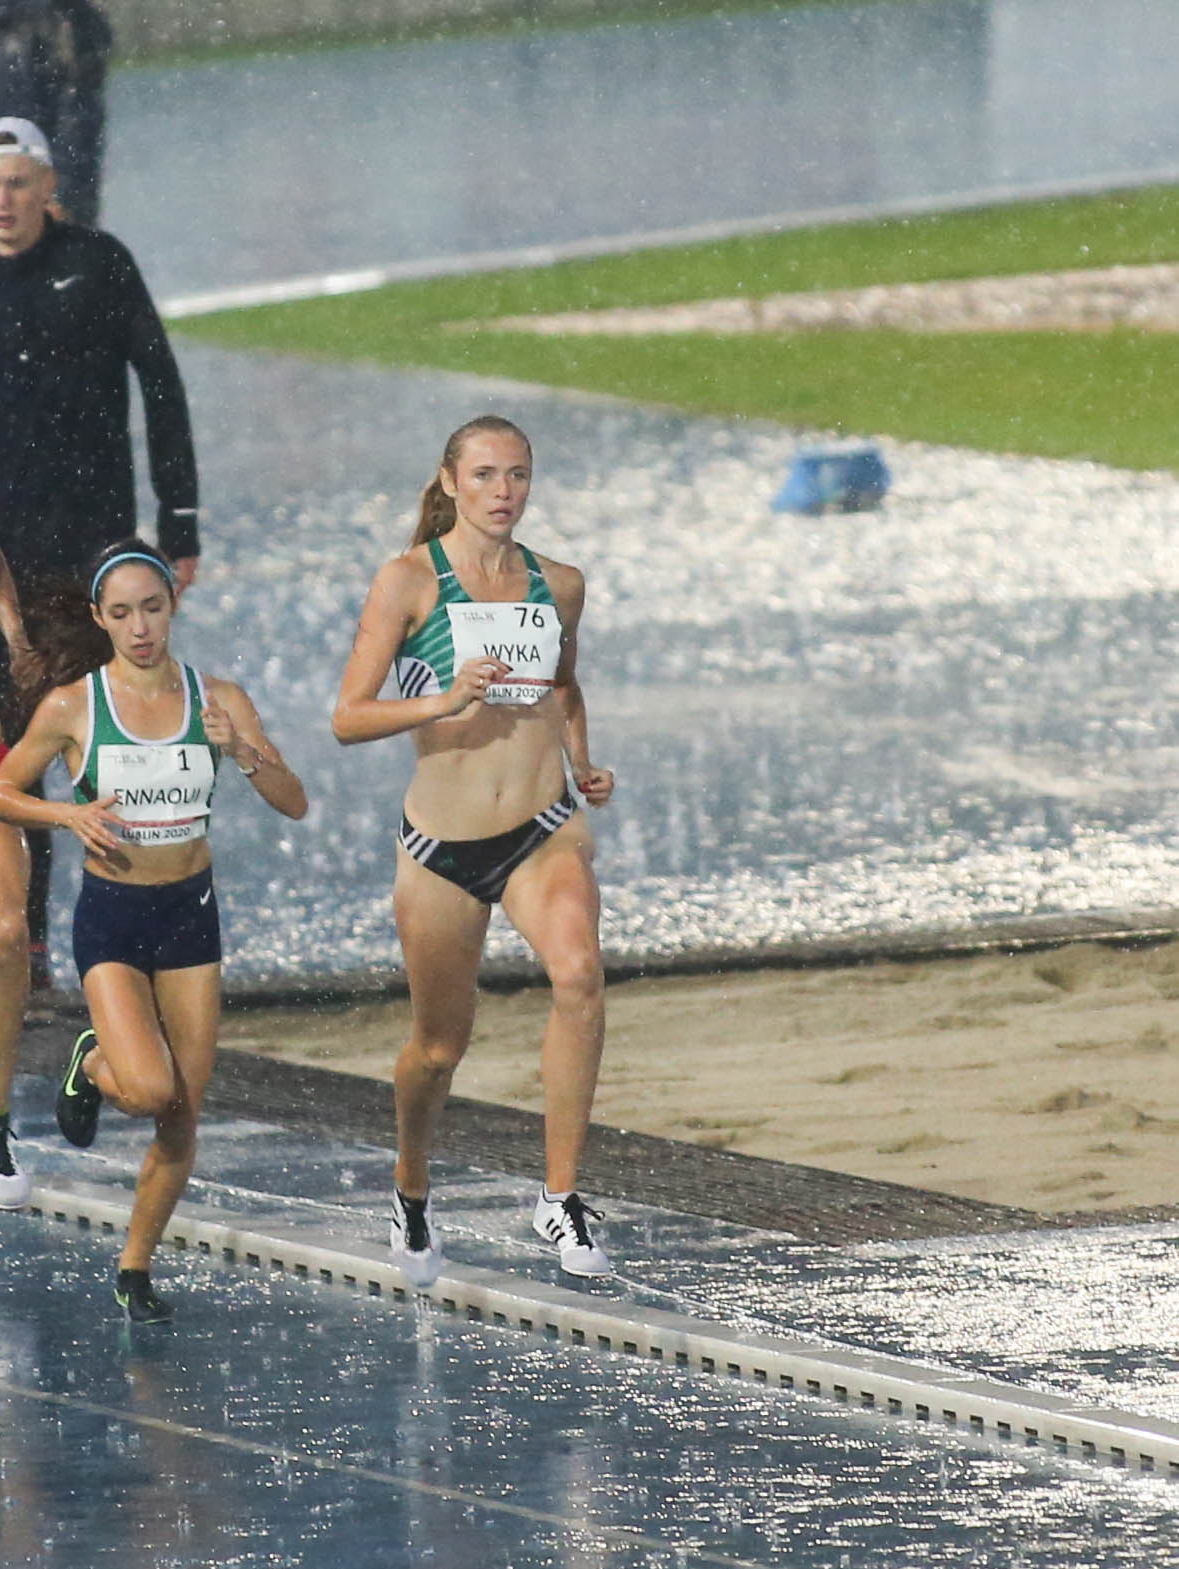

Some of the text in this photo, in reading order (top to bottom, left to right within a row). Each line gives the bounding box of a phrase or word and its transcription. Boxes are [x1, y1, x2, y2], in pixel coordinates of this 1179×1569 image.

[514, 607, 545, 628] 76
[483, 644, 541, 662] WYKA
[516, 686, 543, 699] 2020
[177, 748, 191, 772] 1
[113, 787, 201, 806] ENNAOUI
[163, 826, 191, 840] 2020
